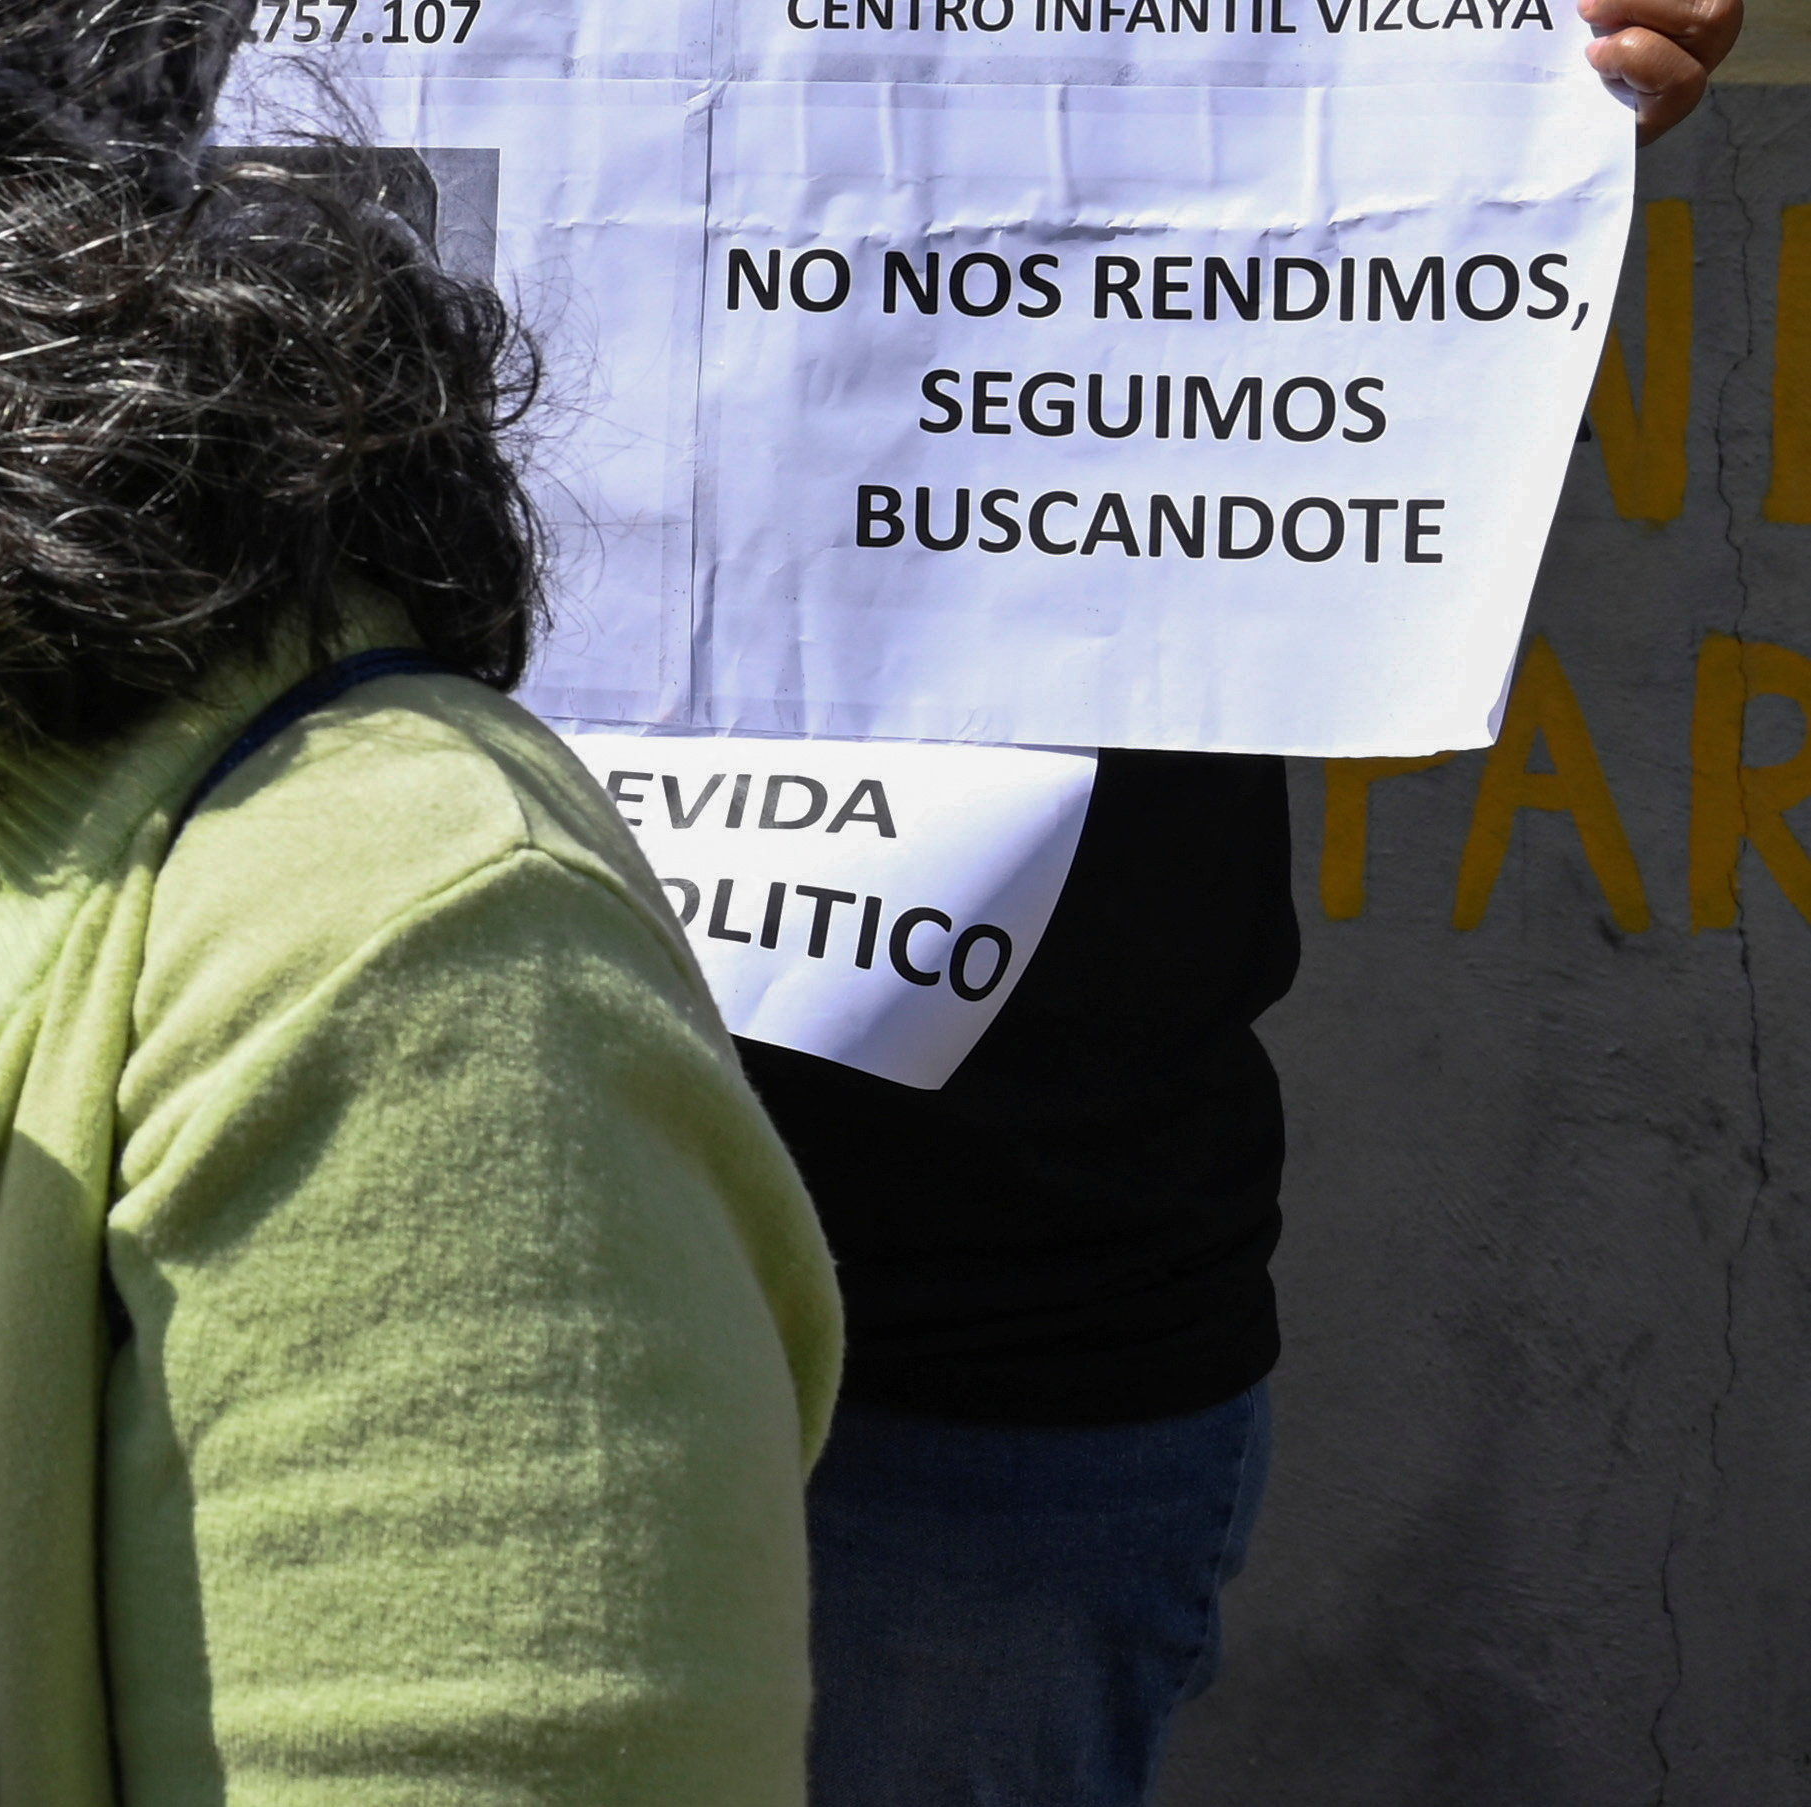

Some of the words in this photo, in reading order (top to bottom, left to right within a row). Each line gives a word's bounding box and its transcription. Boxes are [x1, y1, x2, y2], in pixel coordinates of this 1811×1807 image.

[727, 248, 851, 313] NO
[882, 250, 1062, 319] NOS
[1093, 253, 1589, 331] RENDIMOS,
[919, 368, 1386, 443] SEGUIMOS
[855, 484, 1445, 563] BUSCANDOTE
